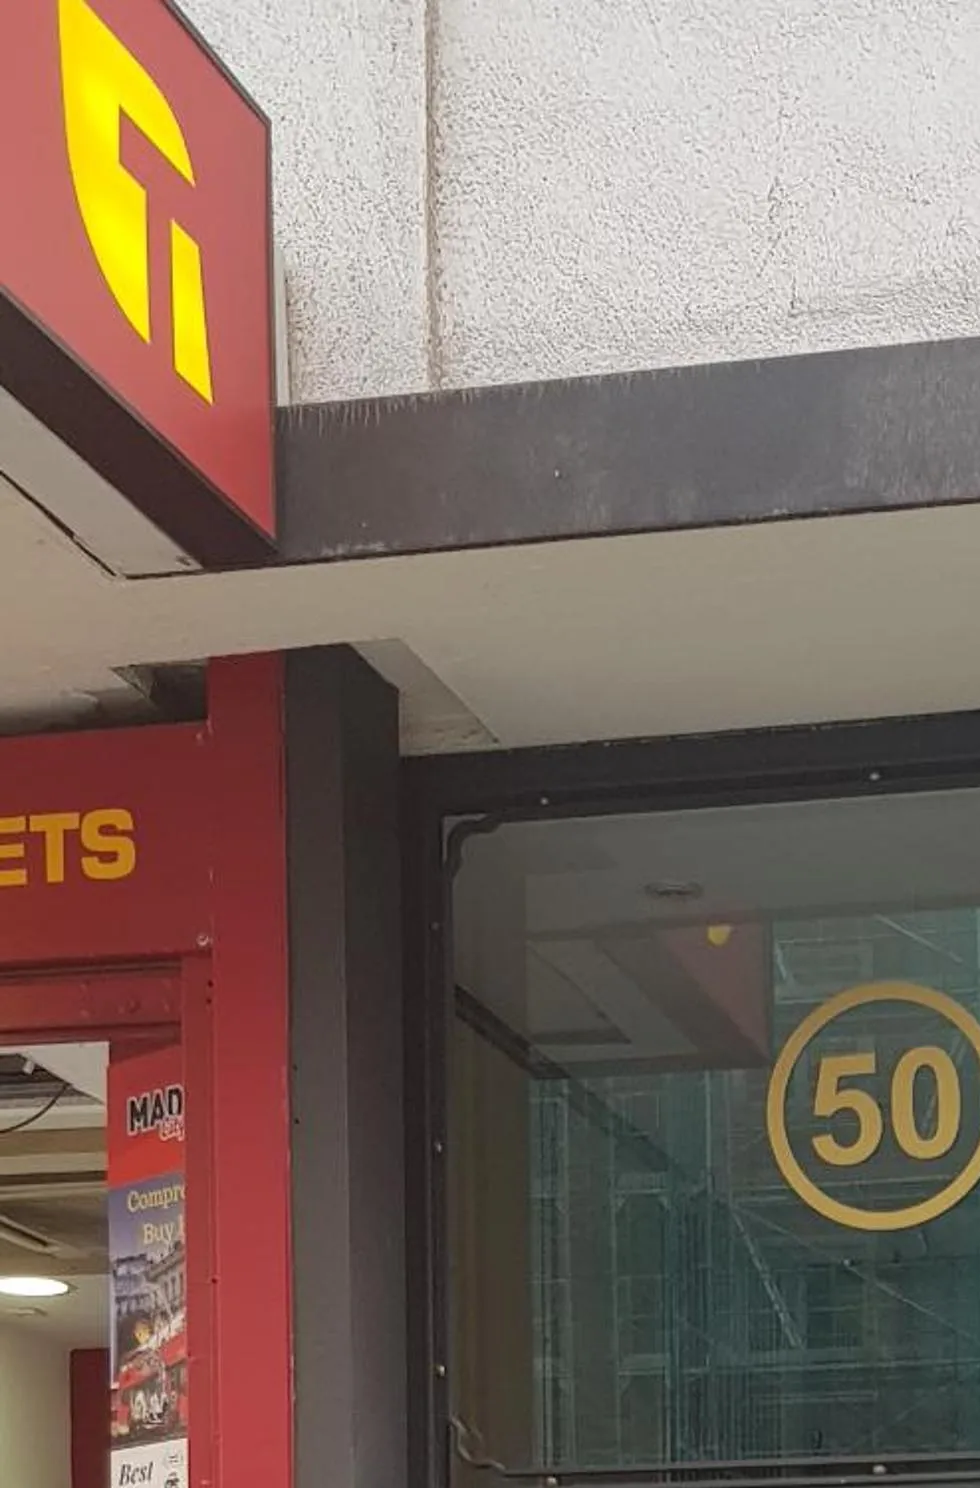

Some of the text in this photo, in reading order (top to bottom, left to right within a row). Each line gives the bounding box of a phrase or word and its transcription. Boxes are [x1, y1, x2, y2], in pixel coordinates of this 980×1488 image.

[811, 1045, 961, 1166] 50
[142, 1220, 175, 1245] Buy
[118, 1461, 154, 1487] Best
